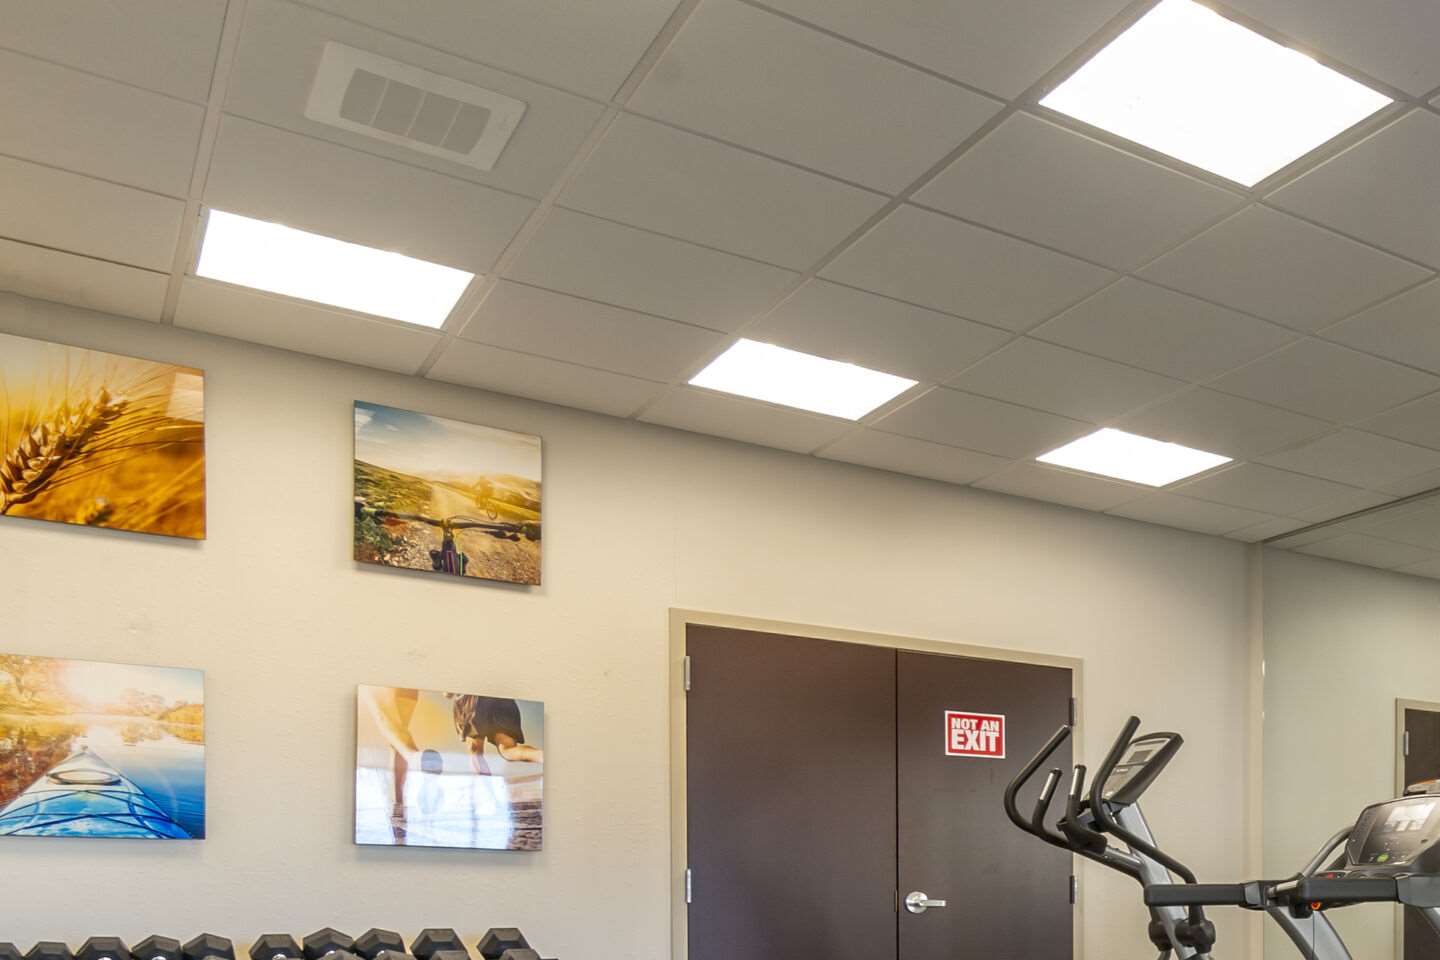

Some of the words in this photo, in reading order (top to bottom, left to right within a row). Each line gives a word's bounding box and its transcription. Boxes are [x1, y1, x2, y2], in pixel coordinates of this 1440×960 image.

[951, 717, 978, 731] NOT
[981, 719, 1000, 732] AN
[951, 728, 1000, 752] EXIT
